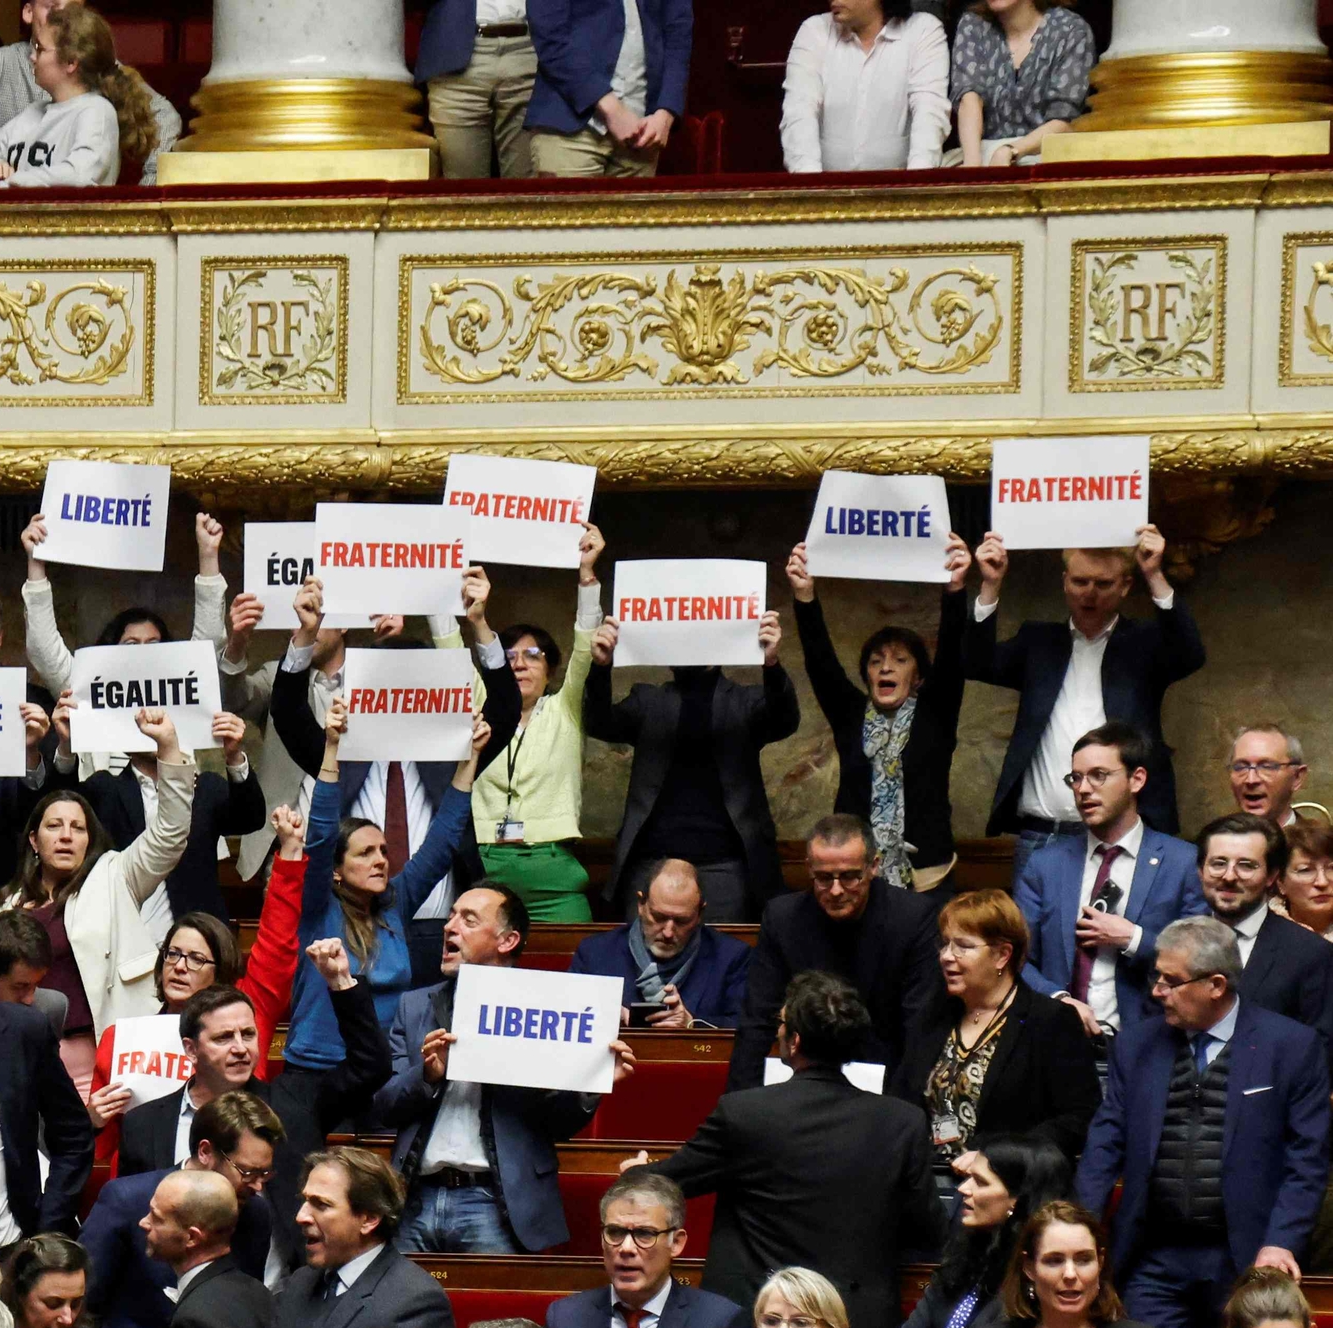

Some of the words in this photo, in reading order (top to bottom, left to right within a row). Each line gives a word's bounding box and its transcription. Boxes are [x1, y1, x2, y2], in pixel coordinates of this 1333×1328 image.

[247, 300, 310, 358] RF
[1120, 282, 1186, 342] RF
[998, 469, 1143, 503] FRATERNITÉ
[60, 492, 152, 528] LIBERTÉ
[825, 504, 932, 538] LIBERTÉ
[320, 538, 464, 569] FRATERNITÉ
[619, 591, 759, 622] FRATERNITÉ
[90, 670, 200, 710] ÉGALITÉ
[349, 682, 473, 714] FRATERNITÉ
[477, 1004, 595, 1044] LIBERTÉ
[693, 1044, 712, 1053] 542
